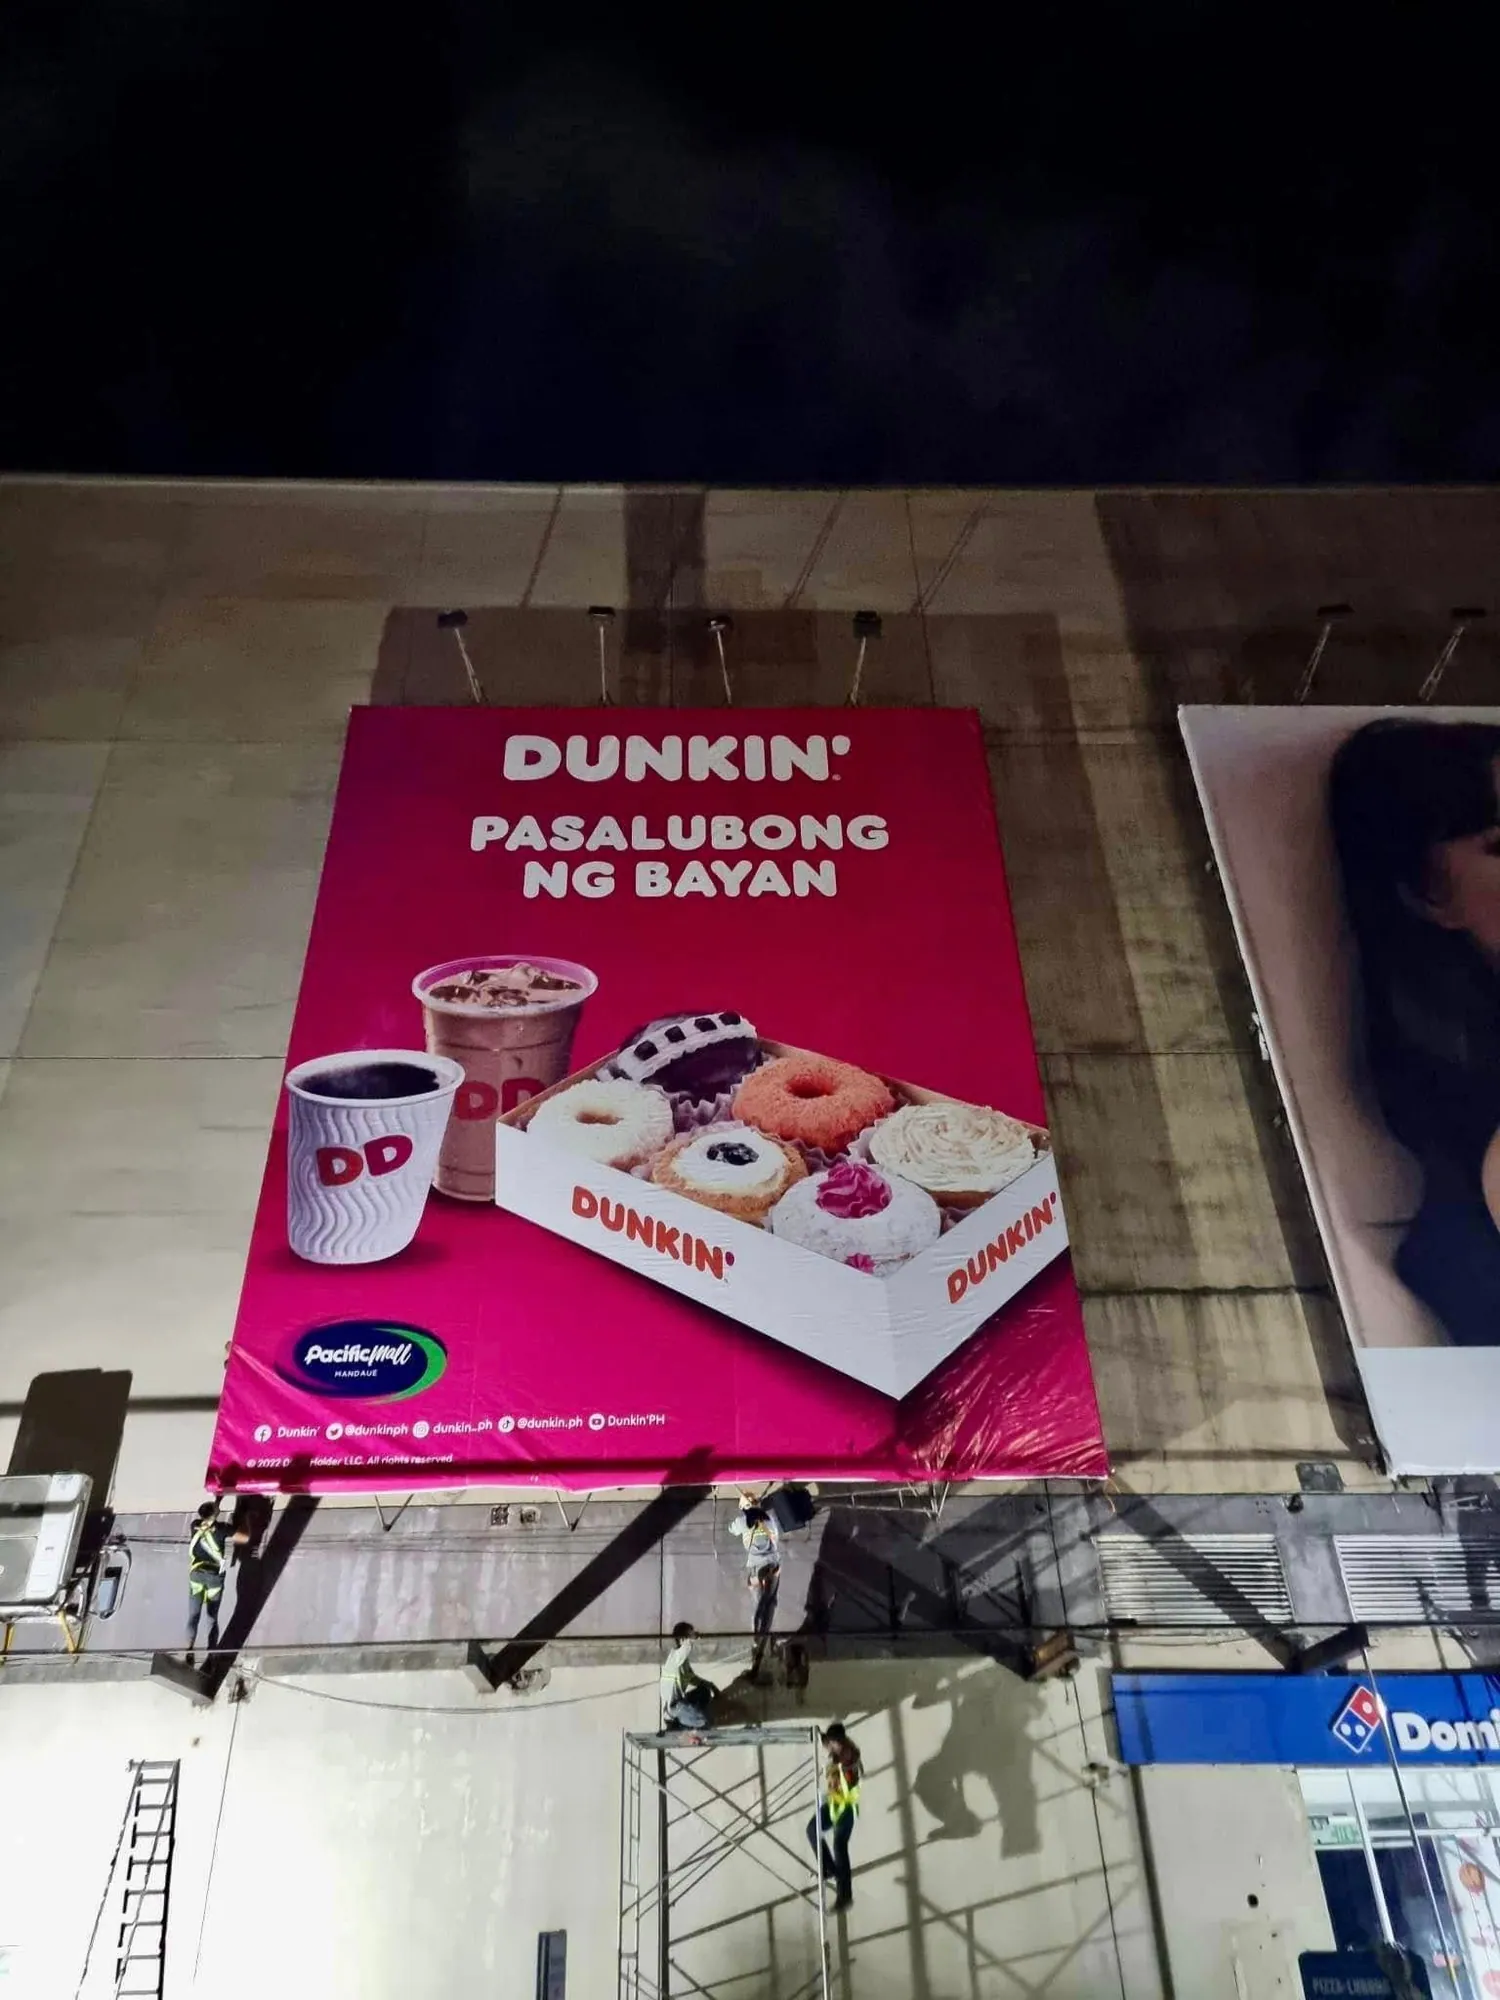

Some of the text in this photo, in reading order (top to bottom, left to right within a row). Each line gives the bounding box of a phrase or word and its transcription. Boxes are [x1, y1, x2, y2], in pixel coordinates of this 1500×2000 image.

[503, 735, 851, 782] DUNKIN'
[470, 815, 889, 851] PASALUBONG
[523, 860, 837, 898] NG BAYAN
[316, 1134, 413, 1187] DD
[572, 1185, 735, 1281] DUNKIN'
[947, 1191, 1057, 1304] DUNKIN'
[334, 1368, 377, 1378] MANDAUE
[257, 1458, 280, 1468] 2022
[310, 1456, 341, 1467] Holder
